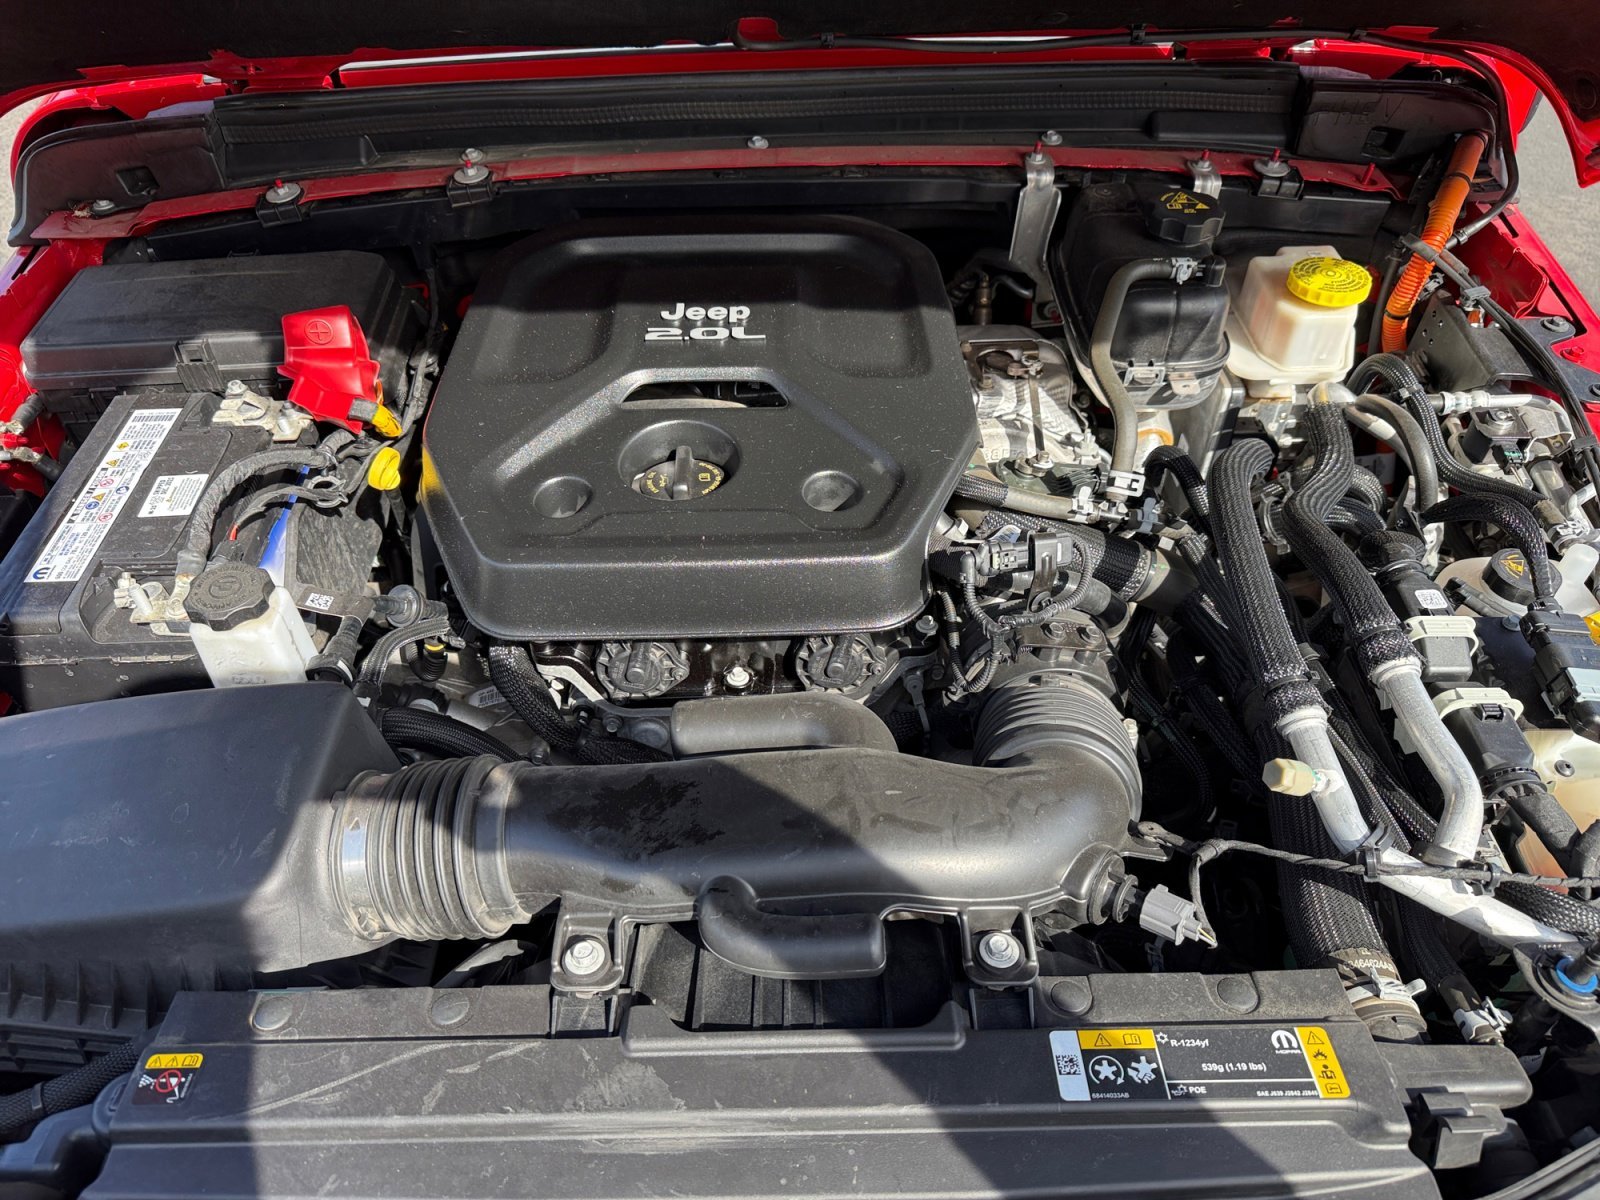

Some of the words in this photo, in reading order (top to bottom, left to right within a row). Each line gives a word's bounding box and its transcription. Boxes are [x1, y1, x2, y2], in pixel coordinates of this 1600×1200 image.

[660, 302, 751, 323] Jeep
[644, 326, 766, 341] 2.0L
[1170, 1038, 1209, 1048] R-1234yf
[1201, 1063, 1224, 1072] 539g
[1225, 1062, 1248, 1072] (1.19
[1249, 1062, 1267, 1072] lbs)
[1188, 1086, 1207, 1094] POE
